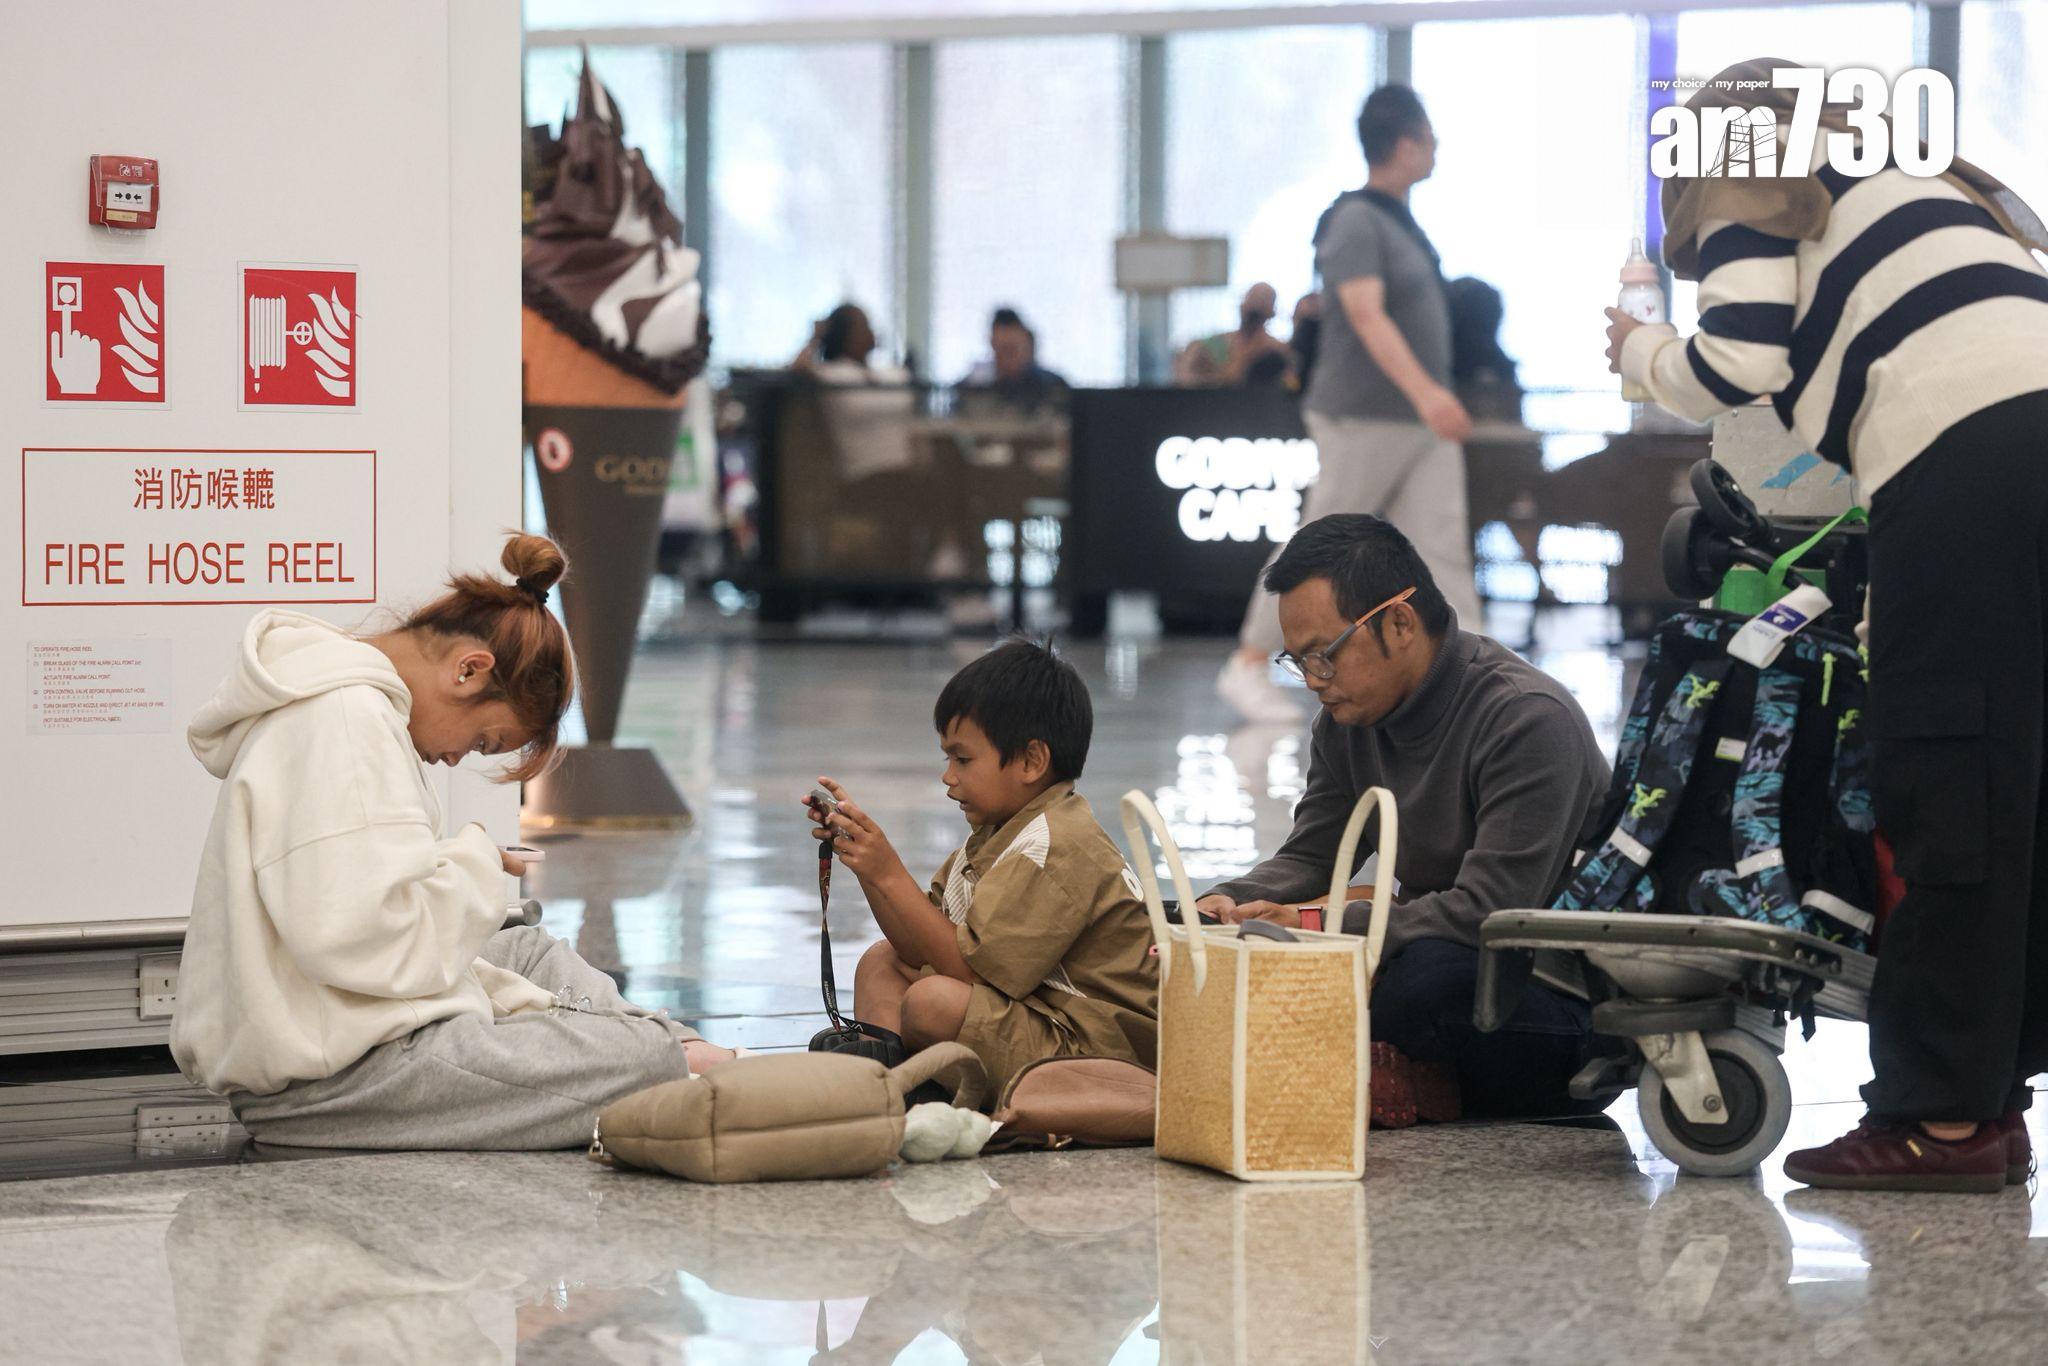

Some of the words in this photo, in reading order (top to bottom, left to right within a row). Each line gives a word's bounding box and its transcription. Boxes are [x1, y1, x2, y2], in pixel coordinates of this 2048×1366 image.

[133, 467, 276, 510] 消防喉轆
[45, 543, 125, 585] FIRE
[149, 542, 245, 585] HOSE
[268, 542, 355, 583] REEL
